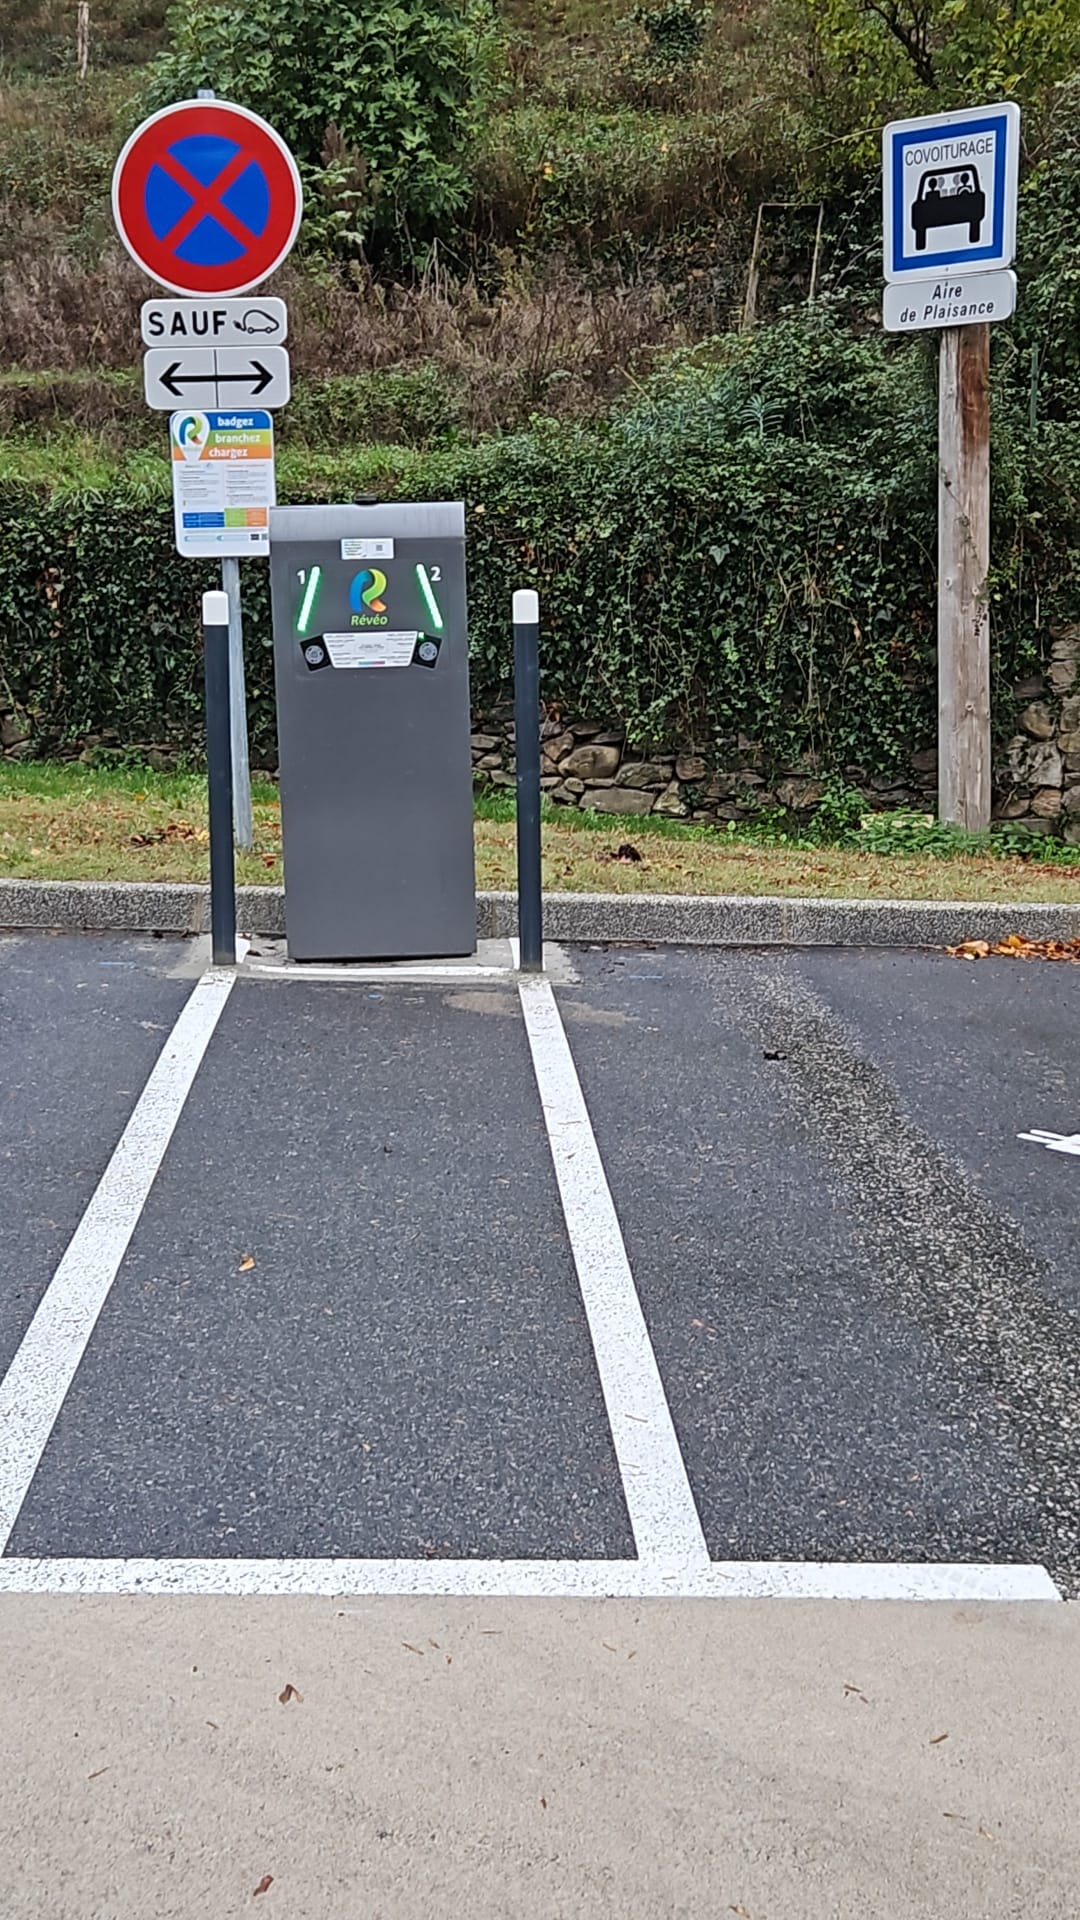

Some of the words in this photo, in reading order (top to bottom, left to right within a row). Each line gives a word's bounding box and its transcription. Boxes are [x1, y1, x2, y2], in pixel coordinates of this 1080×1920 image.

[905, 137, 993, 166] COVOITURAGE
[932, 282, 962, 300] Aire
[900, 308, 916, 322] de
[923, 301, 994, 320] Plaisance
[148, 310, 228, 336] SAUF
[217, 416, 254, 428] badgez
[215, 433, 261, 443] branchez
[208, 448, 249, 459] chargez
[297, 570, 306, 584] 1
[430, 566, 442, 581] 2
[351, 613, 388, 626] Révéo
